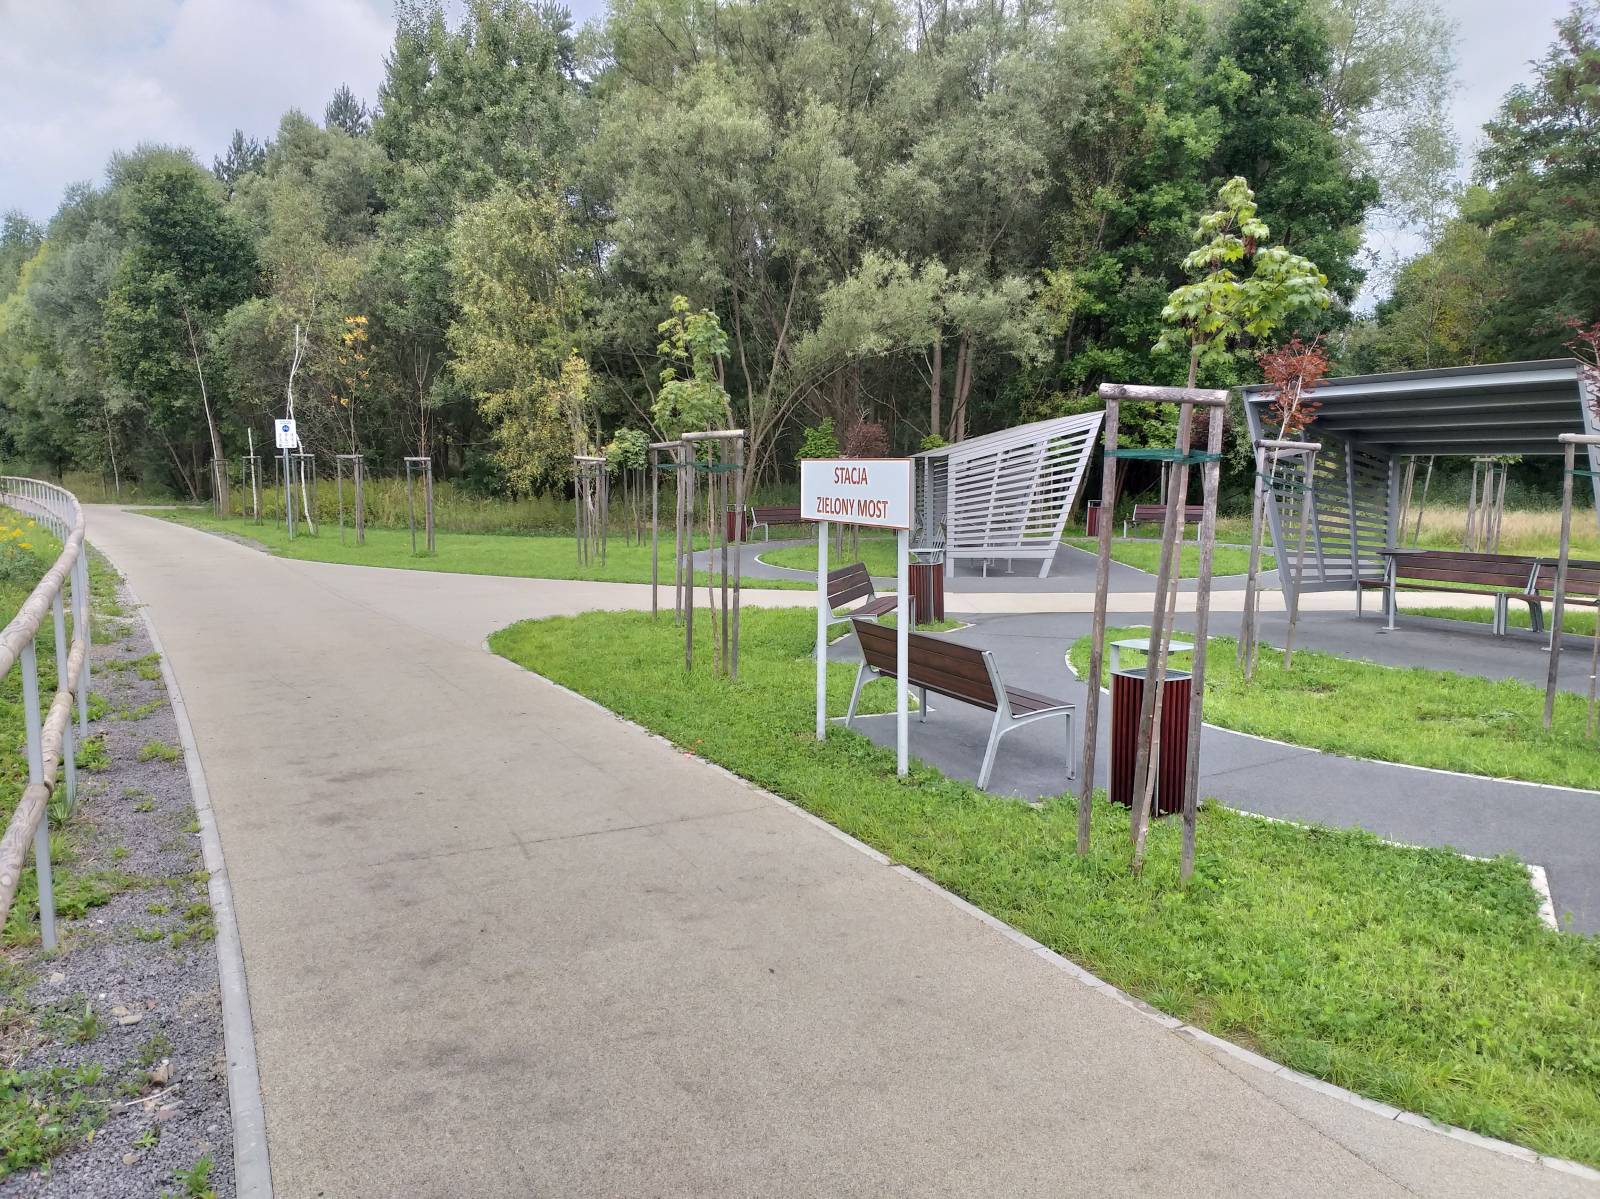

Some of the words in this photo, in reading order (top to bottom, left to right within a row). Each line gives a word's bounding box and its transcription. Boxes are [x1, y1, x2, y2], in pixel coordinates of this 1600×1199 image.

[834, 467, 868, 485] STACJA
[816, 496, 855, 515] ZIELONY
[857, 500, 889, 519] MOST
